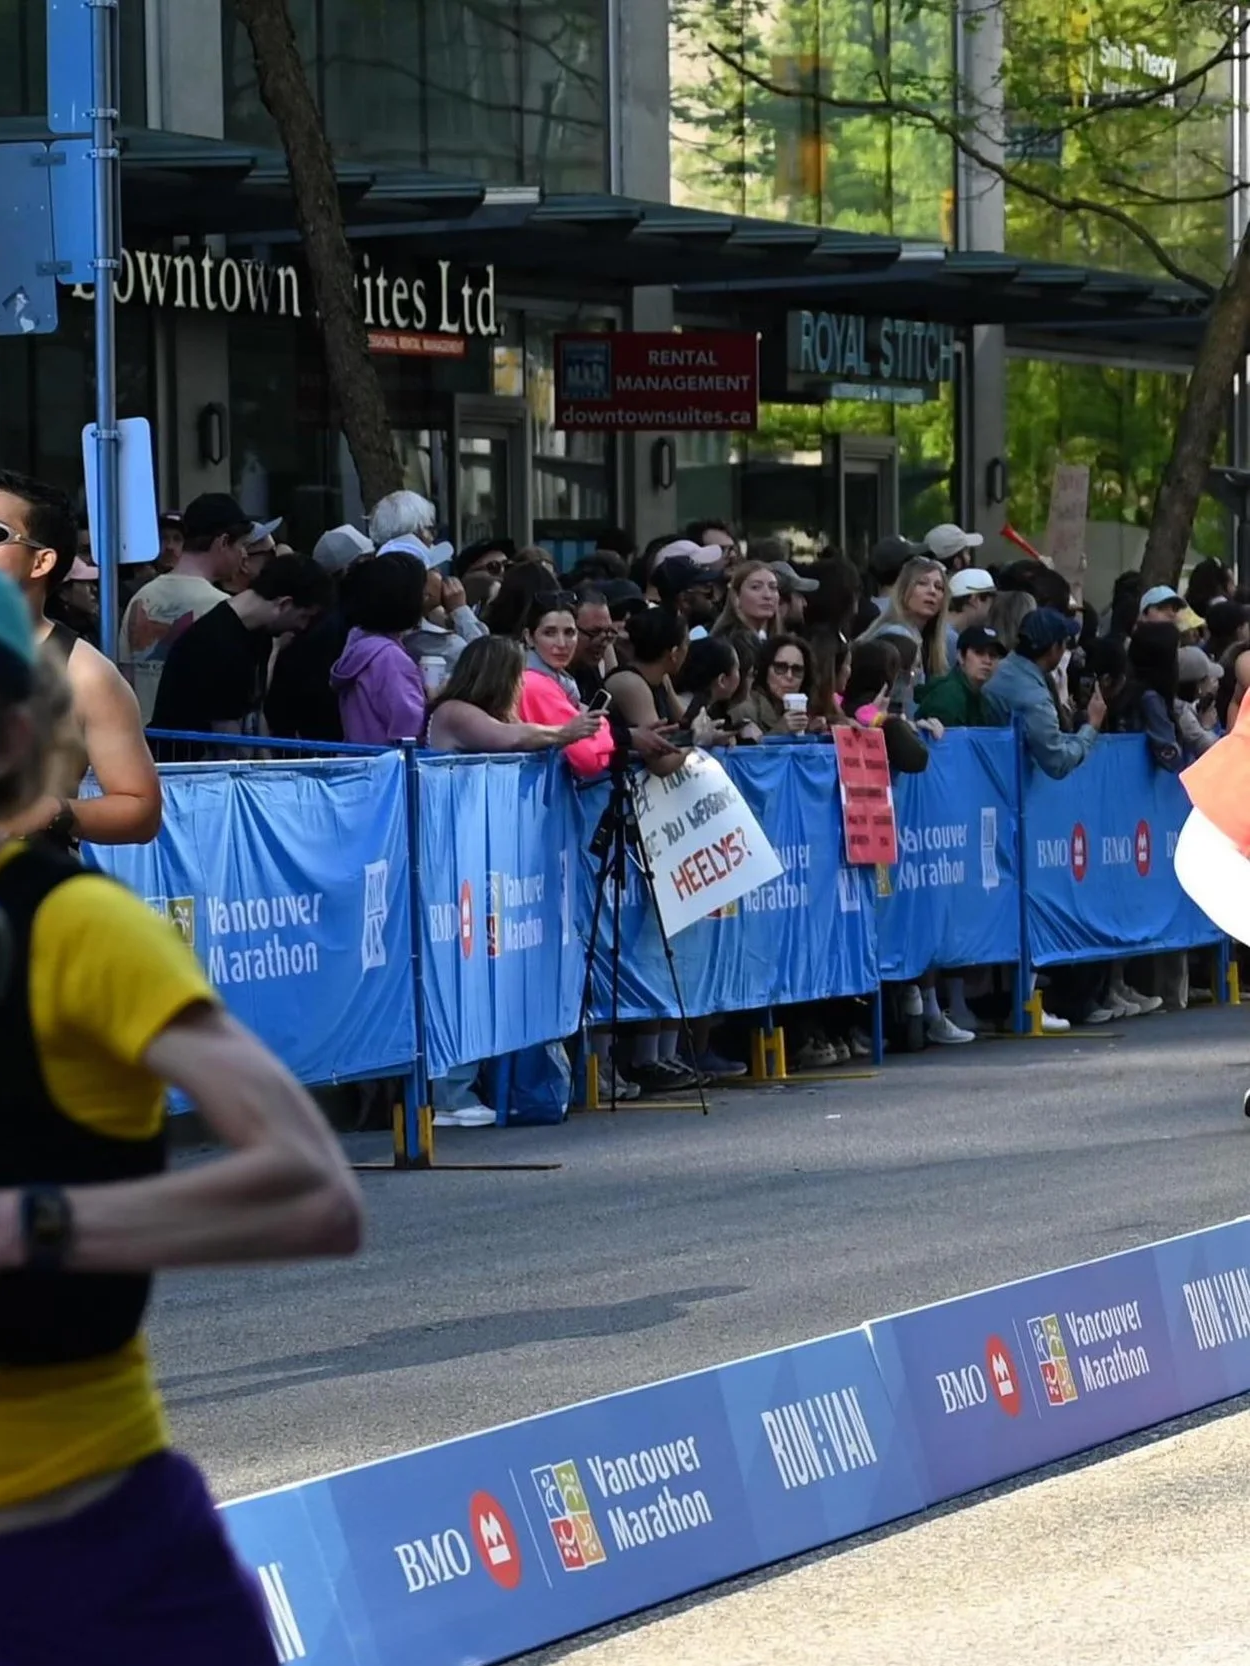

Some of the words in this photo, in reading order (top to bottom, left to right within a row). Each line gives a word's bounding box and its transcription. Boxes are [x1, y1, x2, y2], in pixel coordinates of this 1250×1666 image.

[72, 246, 301, 318] owntown
[353, 253, 426, 331] ites
[439, 259, 505, 337] Ltd.
[648, 350, 718, 366] RENTAL
[800, 310, 871, 376] ROYAL
[879, 316, 955, 382] STITCH
[616, 375, 750, 391] MANAGEMENT
[562, 405, 751, 425] downtownsuites.ca
[670, 826, 753, 902] HEELYS?
[1037, 838, 1068, 868] BMO
[1102, 836, 1132, 864] BMO
[207, 892, 323, 936] Vancouver
[208, 933, 319, 985] Marathon
[1065, 1299, 1143, 1348] Vancouver
[936, 1363, 988, 1415] BMO
[1079, 1340, 1150, 1392] Marathon
[586, 1436, 702, 1498] Vancouver
[606, 1487, 713, 1552] Marathon
[394, 1528, 472, 1593] BMO
